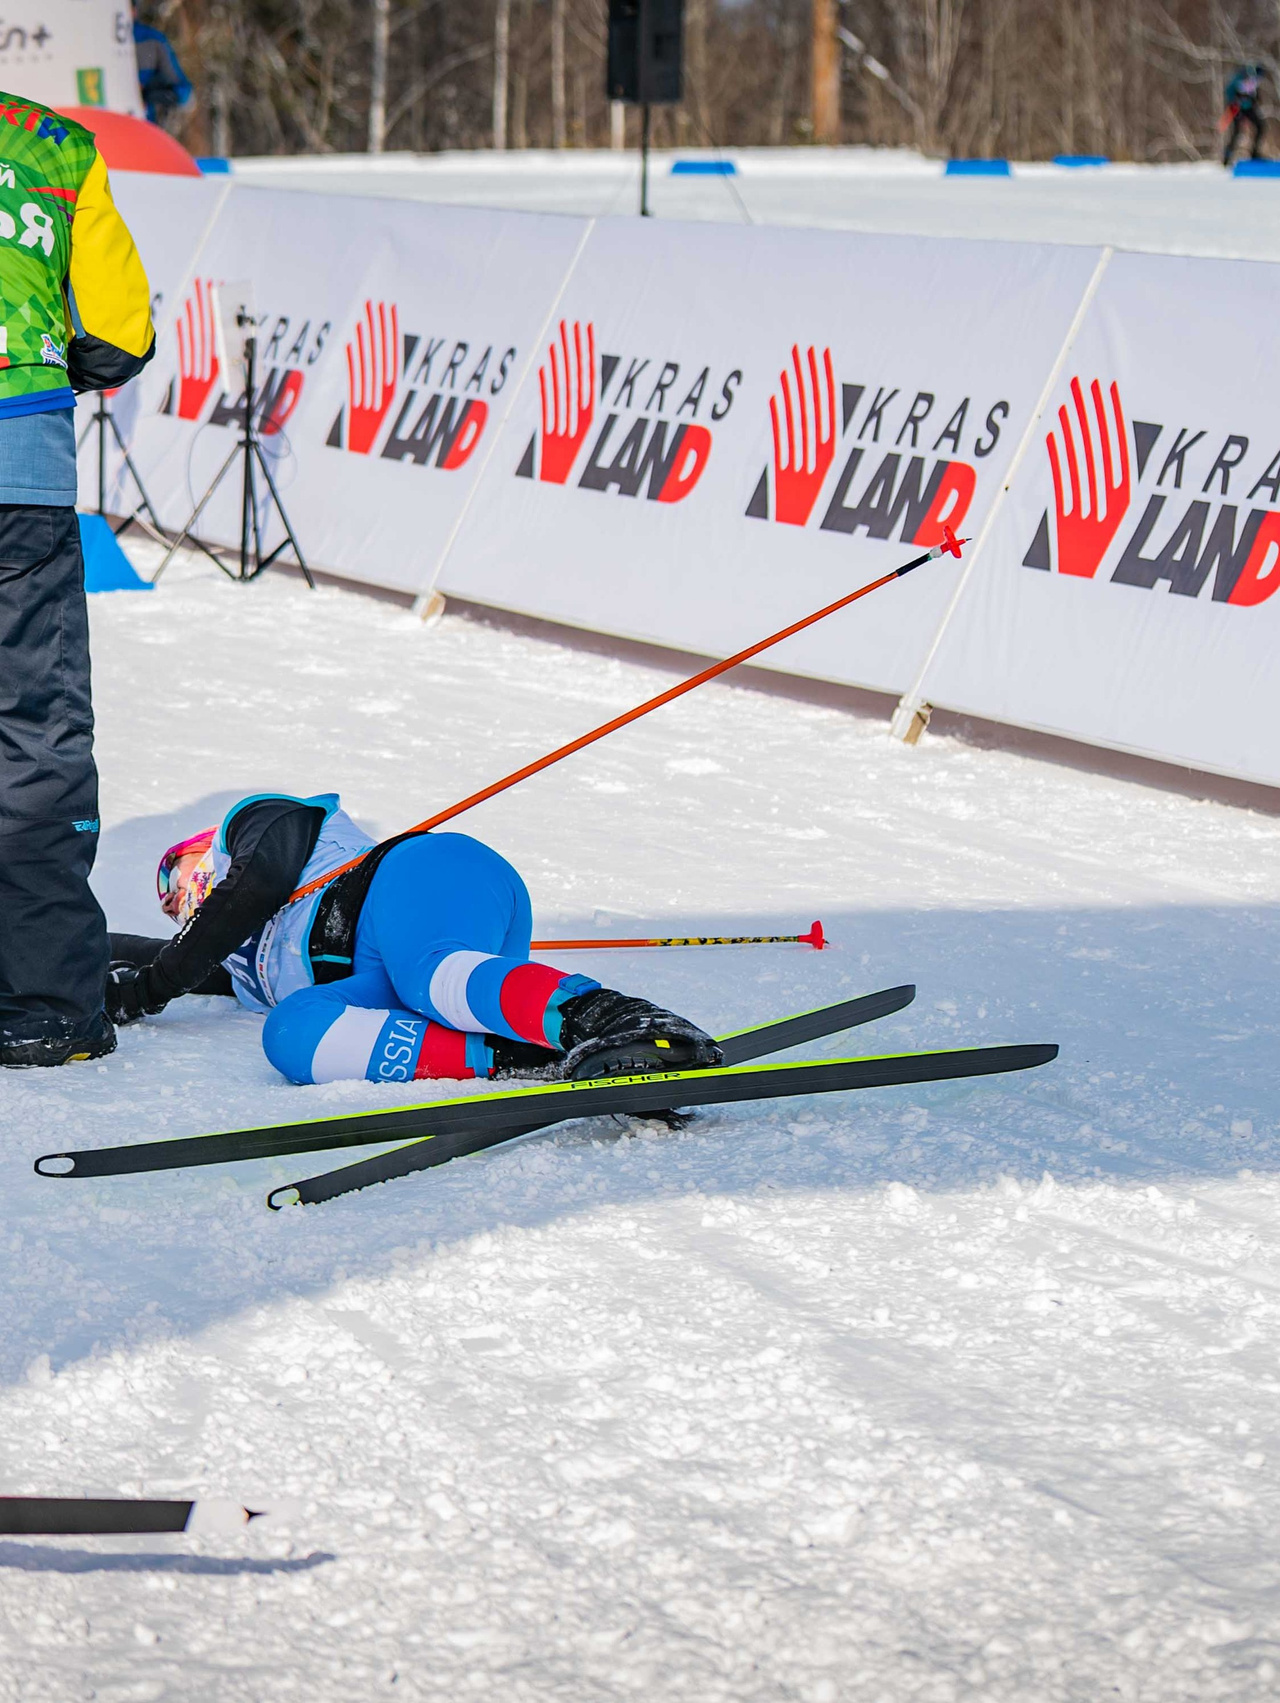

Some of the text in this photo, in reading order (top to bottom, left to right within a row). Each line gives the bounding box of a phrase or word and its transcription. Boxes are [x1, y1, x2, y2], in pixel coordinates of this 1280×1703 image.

[258, 315, 331, 366] RAS
[414, 337, 517, 397] KRAS
[615, 356, 743, 422] KRAS
[858, 387, 1010, 458] KRAS
[380, 390, 489, 471] LAND
[577, 412, 713, 504] LAND
[1157, 427, 1280, 503] KRA
[820, 447, 977, 547] LAND
[1110, 494, 1280, 608] LAND
[377, 1017, 423, 1084] SSIA
[571, 1073, 681, 1089] FISCHER
